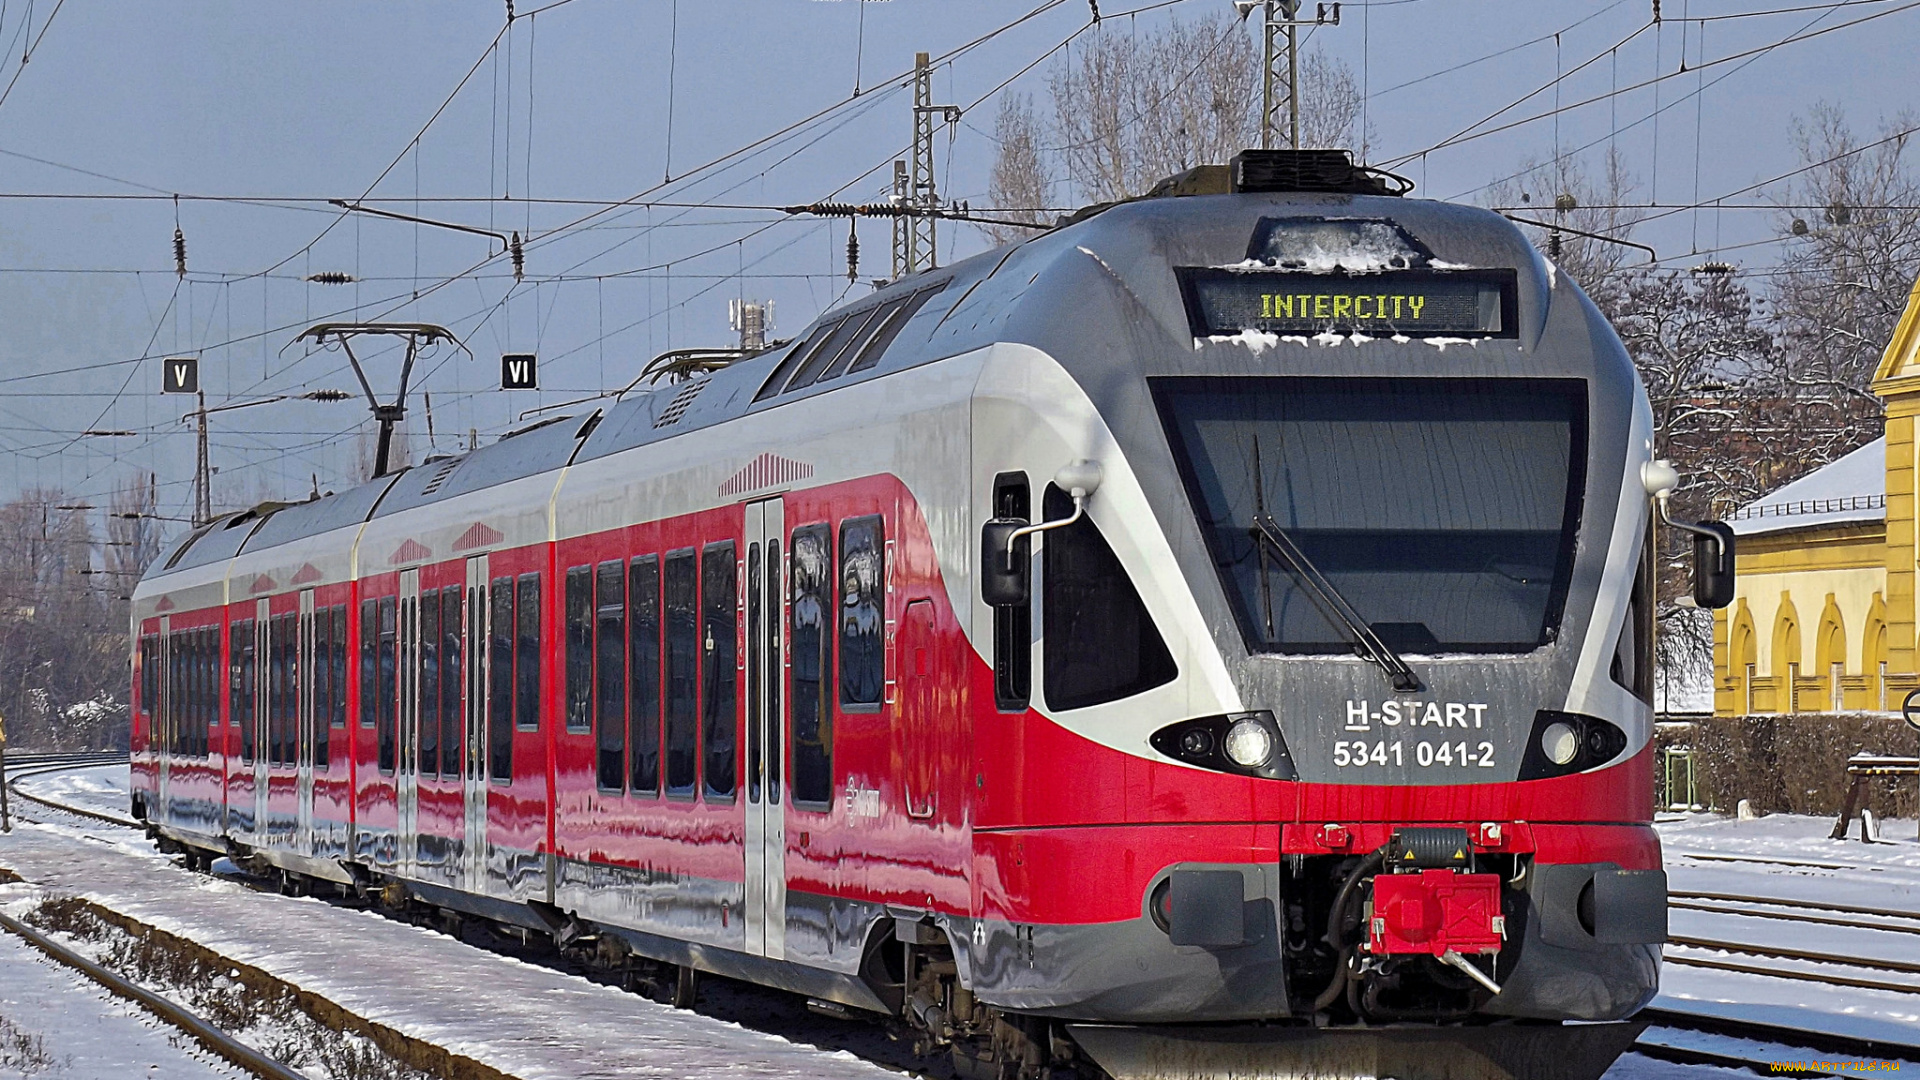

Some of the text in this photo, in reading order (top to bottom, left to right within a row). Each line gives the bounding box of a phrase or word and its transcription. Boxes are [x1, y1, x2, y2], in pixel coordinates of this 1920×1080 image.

[1260, 294, 1424, 319] INTERCITY
[174, 364, 187, 388] V
[508, 360, 529, 384] VI
[1345, 700, 1488, 731] H-START
[1333, 741, 1495, 767] 5341 041-2
